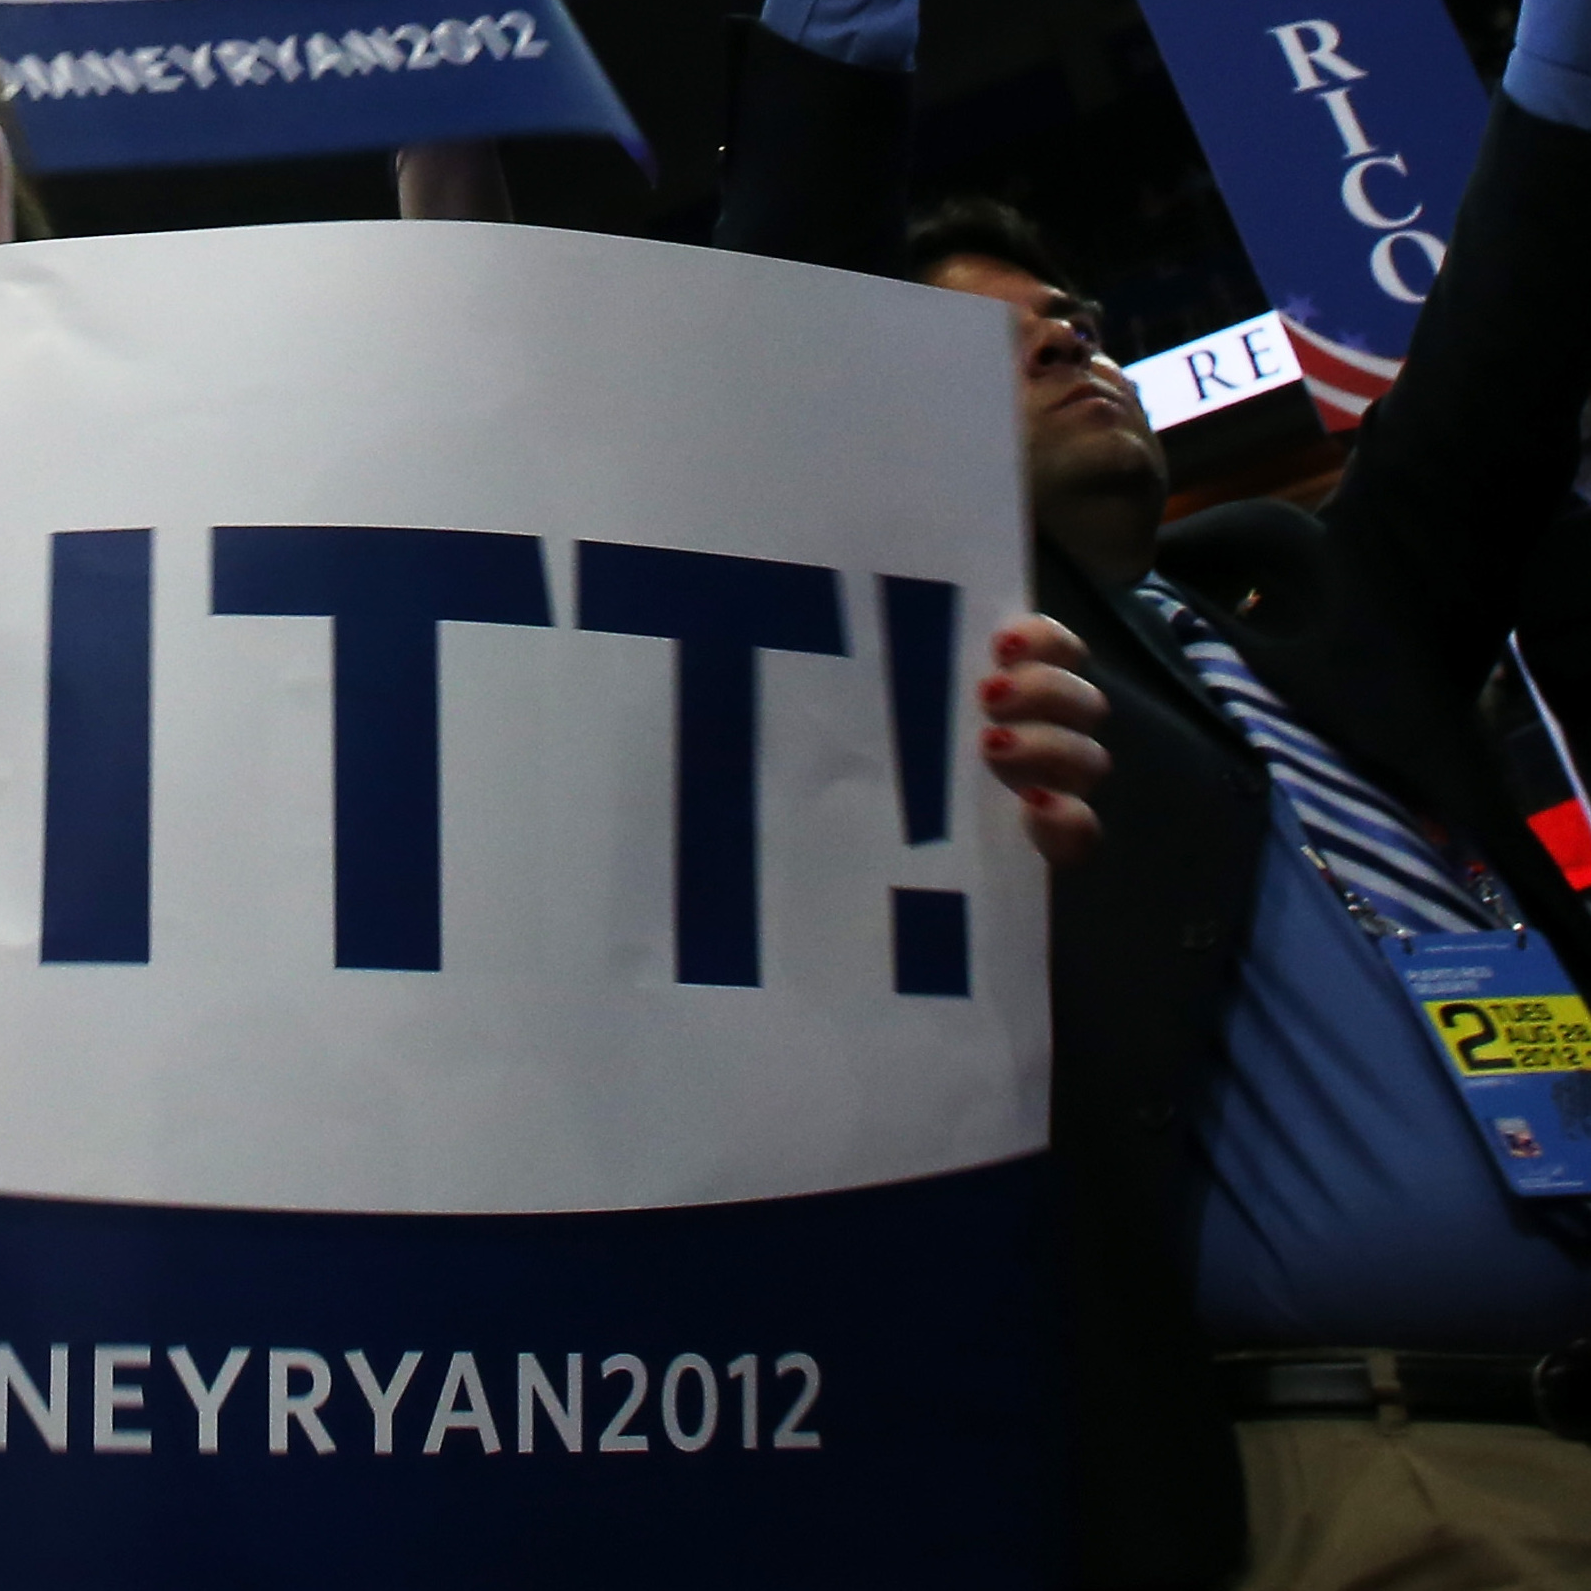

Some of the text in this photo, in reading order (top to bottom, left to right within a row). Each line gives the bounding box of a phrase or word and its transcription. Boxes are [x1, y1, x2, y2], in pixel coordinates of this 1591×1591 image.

[1266, 18, 1447, 305] RICO
[1184, 326, 1282, 402] RE
[1439, 1002, 1516, 1071] 2
